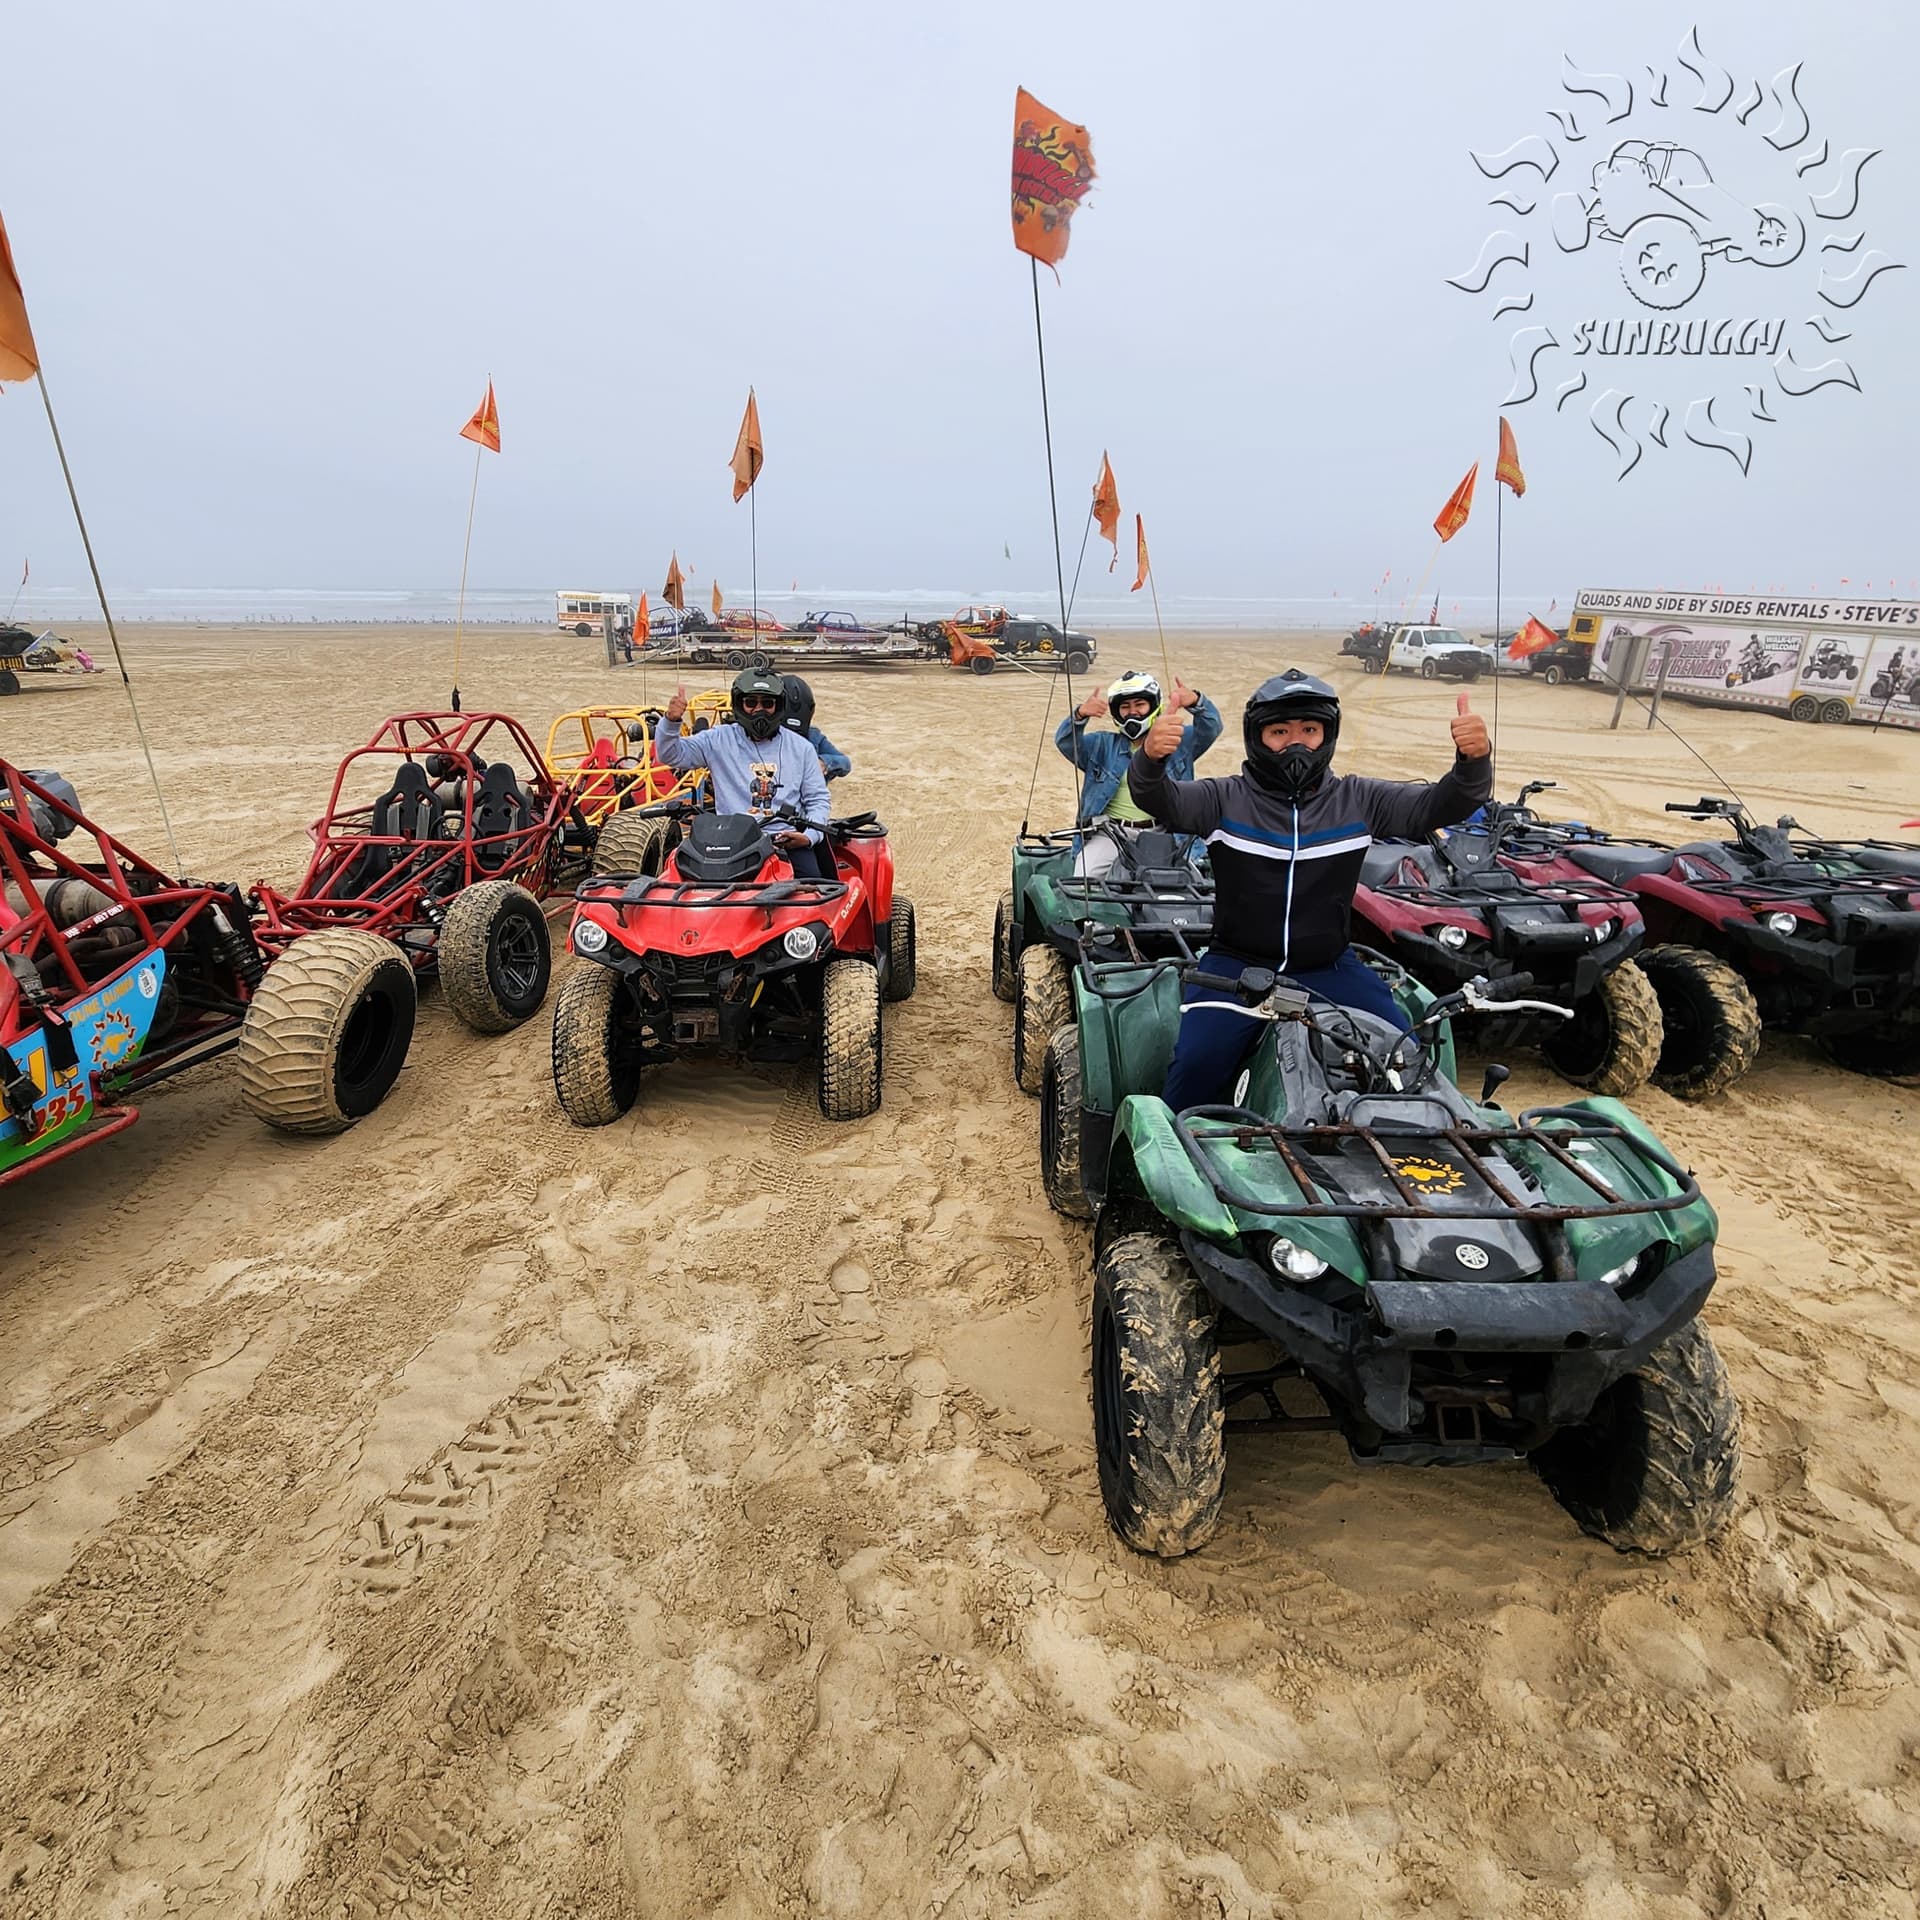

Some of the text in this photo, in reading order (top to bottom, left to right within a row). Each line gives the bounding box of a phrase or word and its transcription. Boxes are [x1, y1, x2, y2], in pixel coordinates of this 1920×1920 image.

[1581, 593, 1919, 624] QUADS AND SIDE BY SIDES RENTALS STEVE'S
